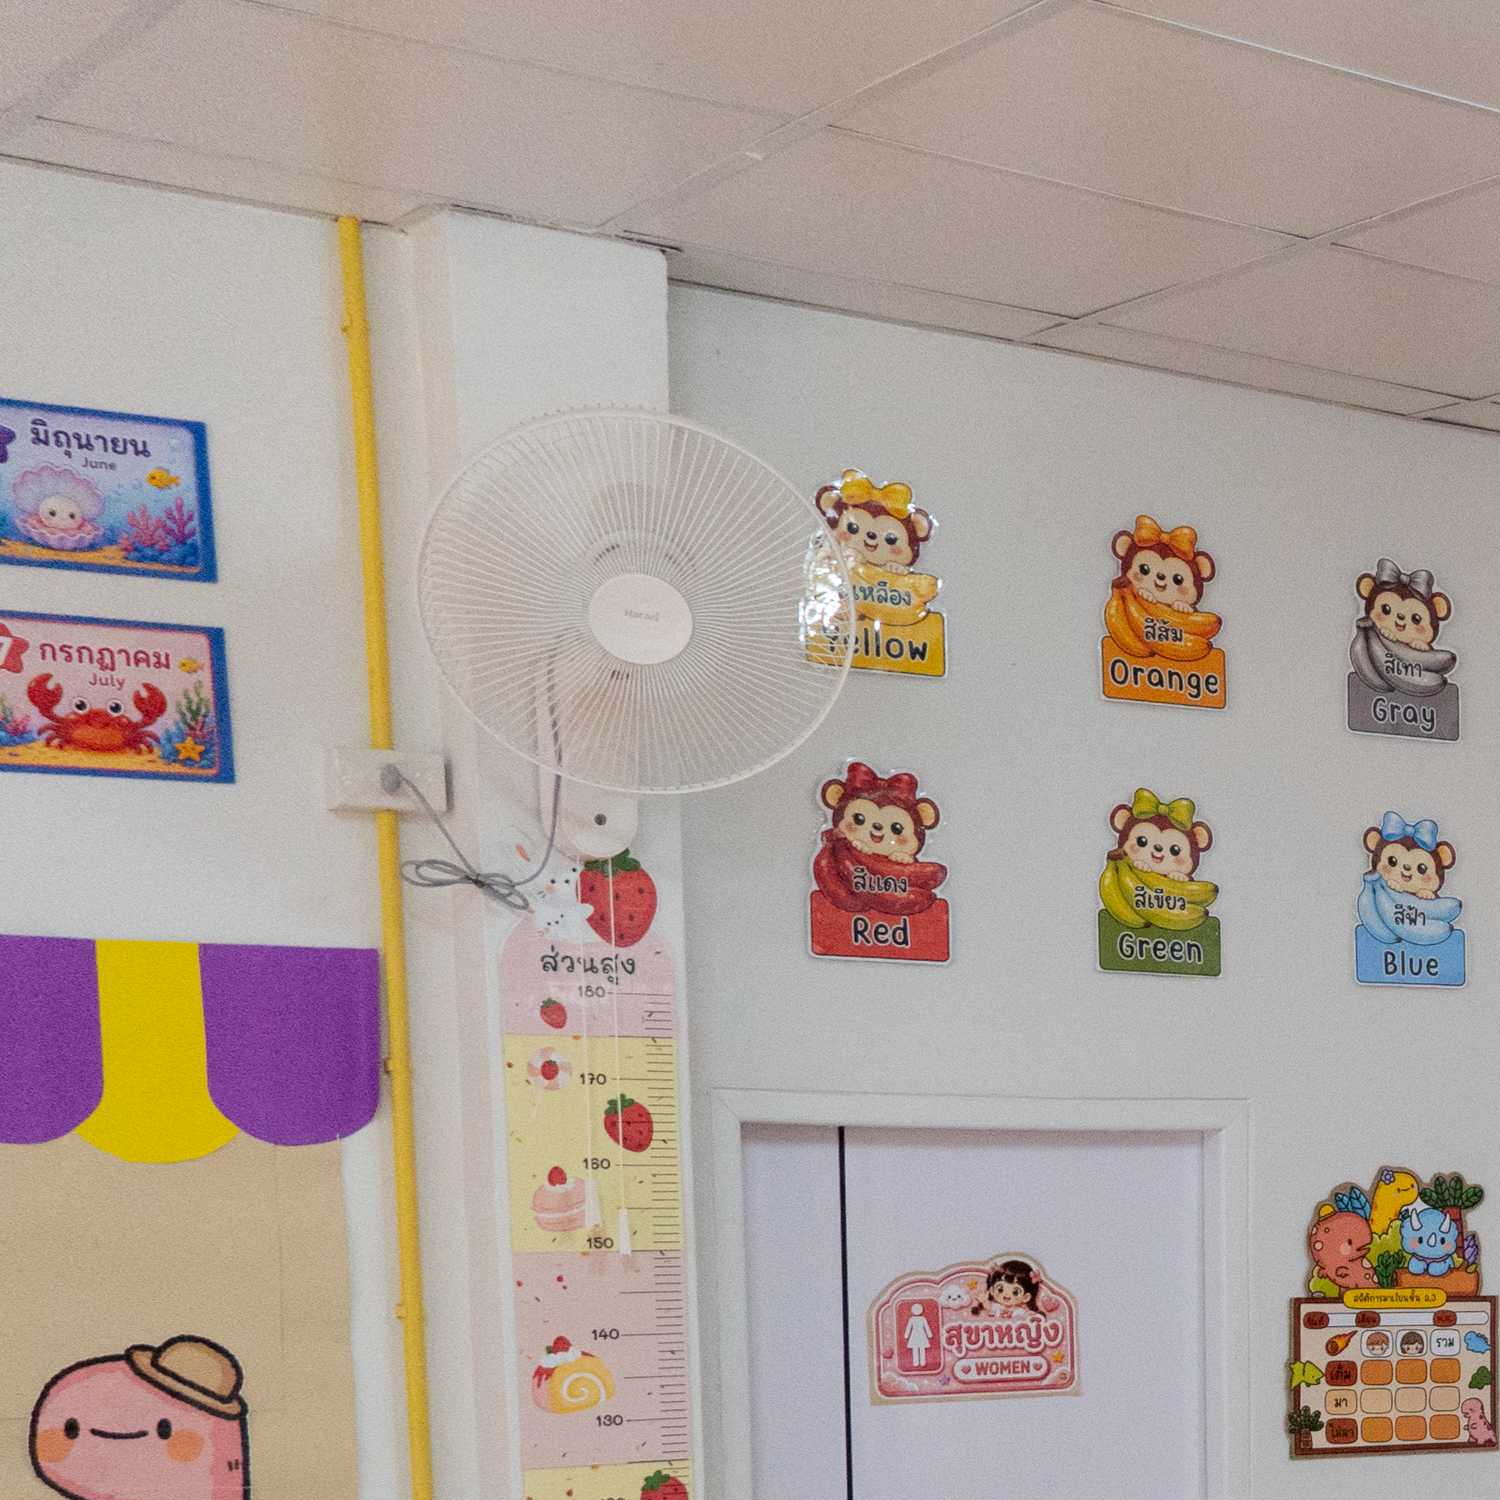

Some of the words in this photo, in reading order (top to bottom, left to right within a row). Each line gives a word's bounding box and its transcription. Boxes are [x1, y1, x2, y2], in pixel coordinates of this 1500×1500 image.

[30, 418, 151, 460] มิถุนายน
[81, 457, 117, 471] June
[1144, 615, 1183, 643] สีส้ม
[40, 641, 171, 672] กรกฎาคม
[1384, 653, 1423, 678] สีเทา
[89, 673, 126, 690] July
[1109, 658, 1219, 698] Orange
[1373, 697, 1436, 731] Gray
[852, 865, 908, 893] สีแดง
[1133, 884, 1187, 912] สีเขียว
[1393, 904, 1426, 926] สีฟ้า
[852, 916, 910, 948] Red
[1118, 931, 1203, 964] Green
[540, 945, 636, 985] ส่วนสูง
[1384, 950, 1439, 977] Blue
[579, 1073, 607, 1086] 170
[585, 1236, 614, 1250] 150
[591, 1327, 620, 1341] 140
[945, 1318, 1063, 1356] สุขาหญิง
[975, 1360, 1030, 1375] WOMEN
[1334, 1398, 1348, 1408] มา
[595, 1414, 624, 1427] 130
